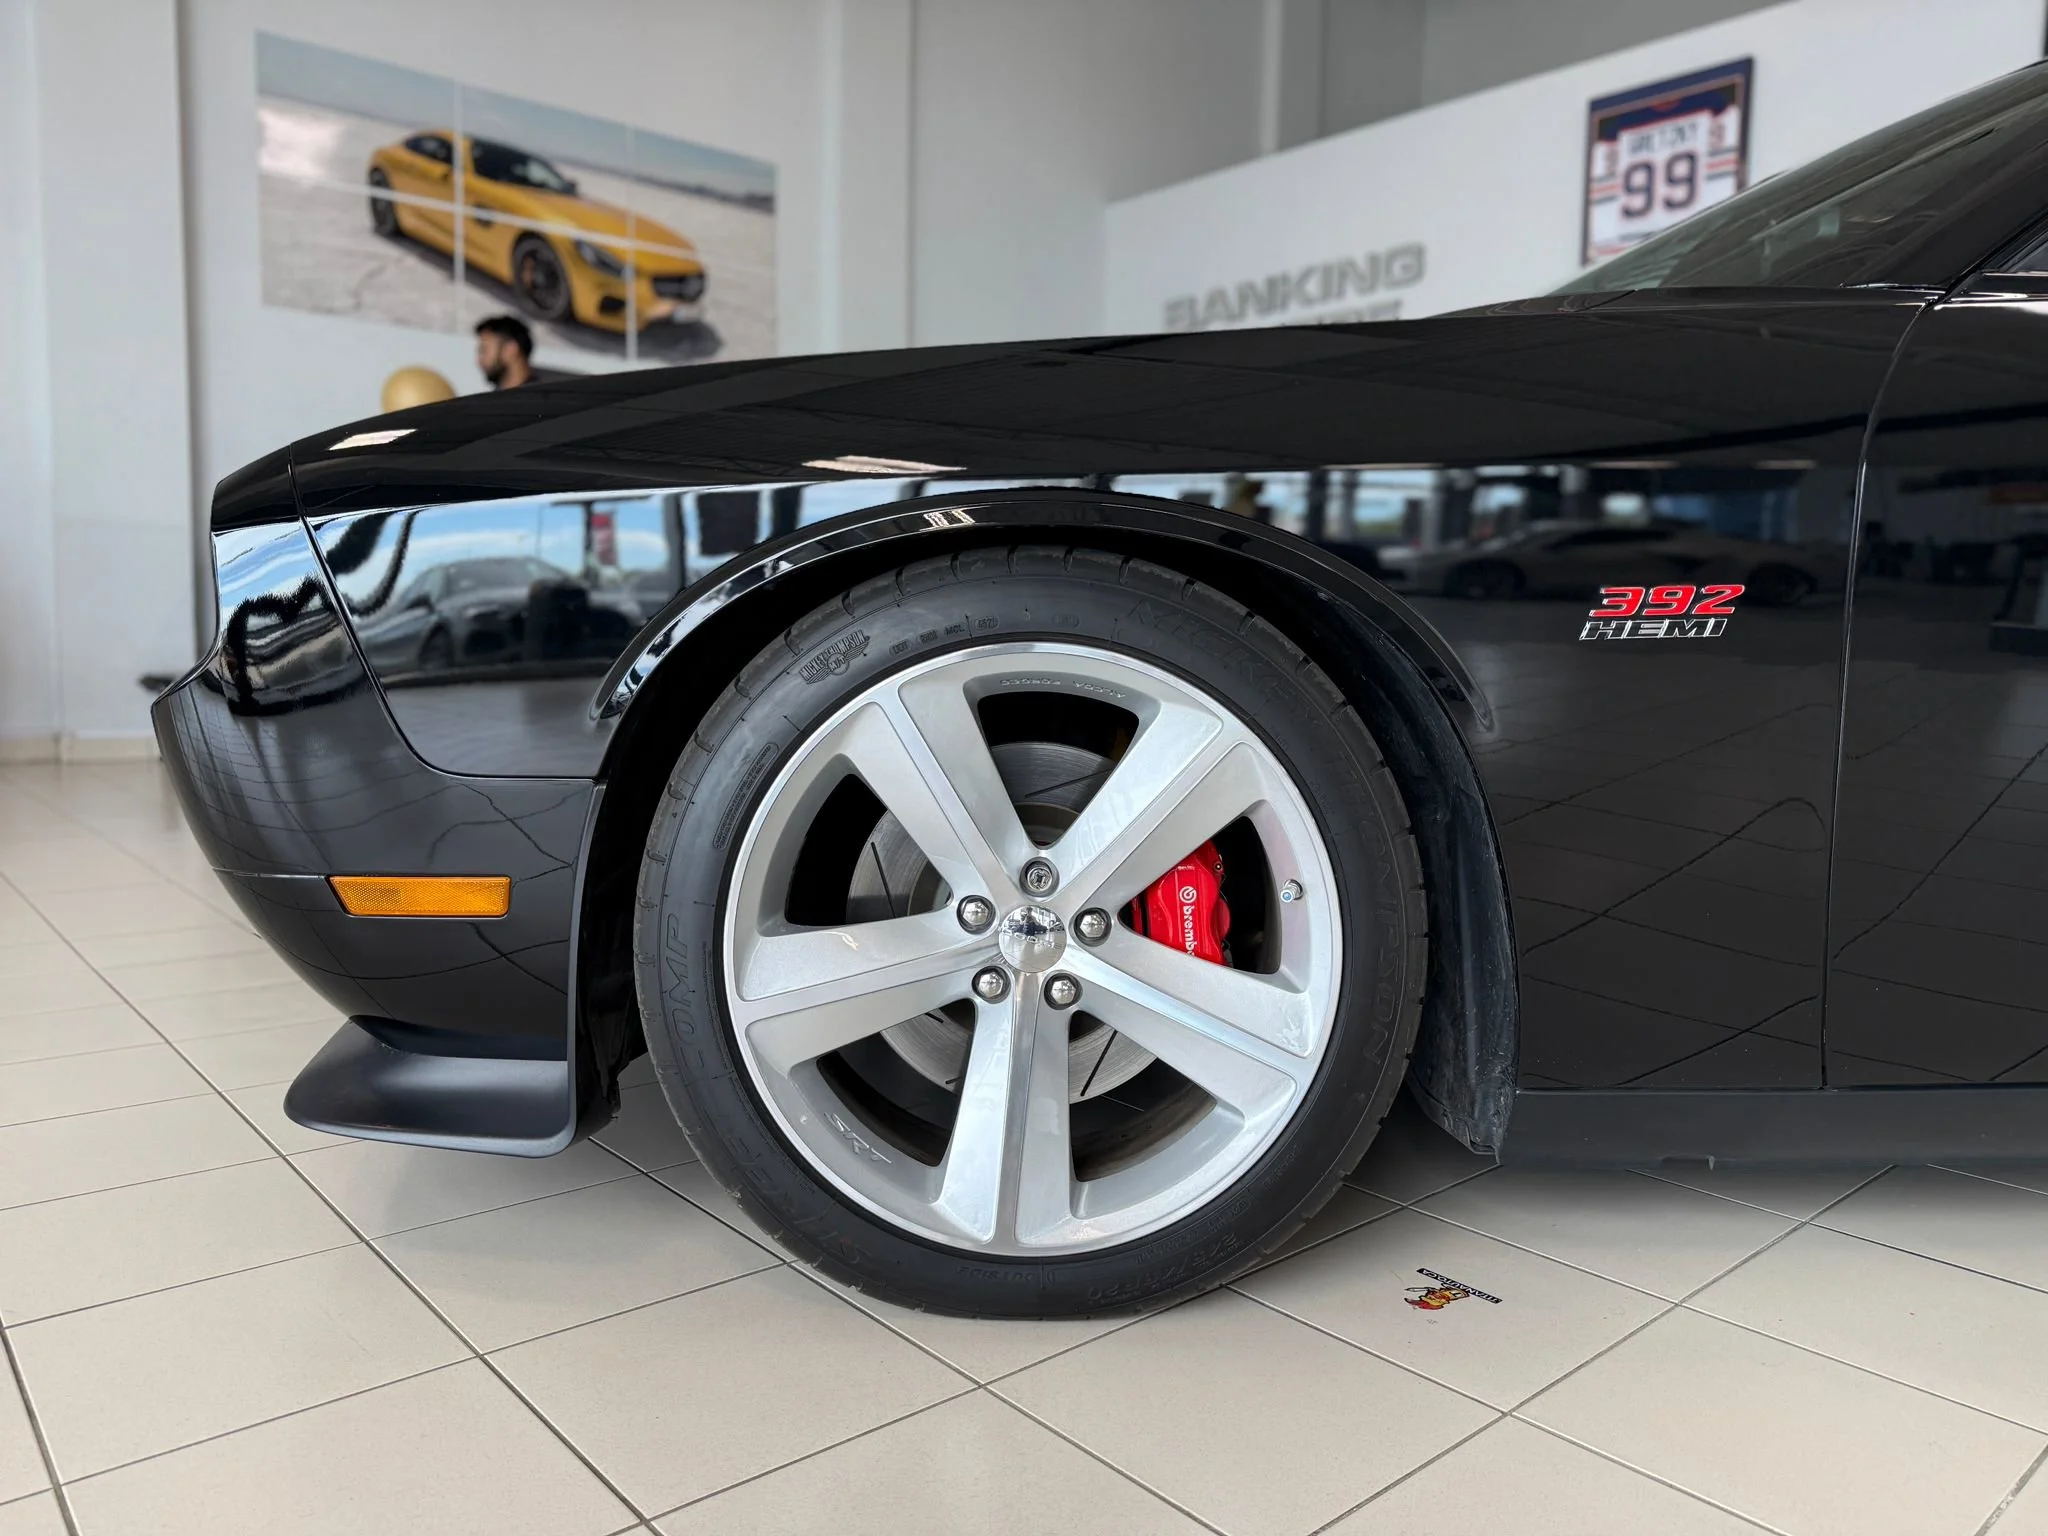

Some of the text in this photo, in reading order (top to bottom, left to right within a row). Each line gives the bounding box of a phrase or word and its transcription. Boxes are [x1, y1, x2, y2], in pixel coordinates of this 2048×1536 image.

[1621, 151, 1698, 218] 99
[1163, 242, 1427, 331] BANKING
[1589, 584, 1745, 616] 392
[1579, 617, 1728, 640] HEMI
[799, 630, 866, 680] MICKEY THOMPSON
[1183, 905, 1197, 956] bremb
[665, 912, 708, 1080] COMP
[823, 1111, 892, 1164] SRT
